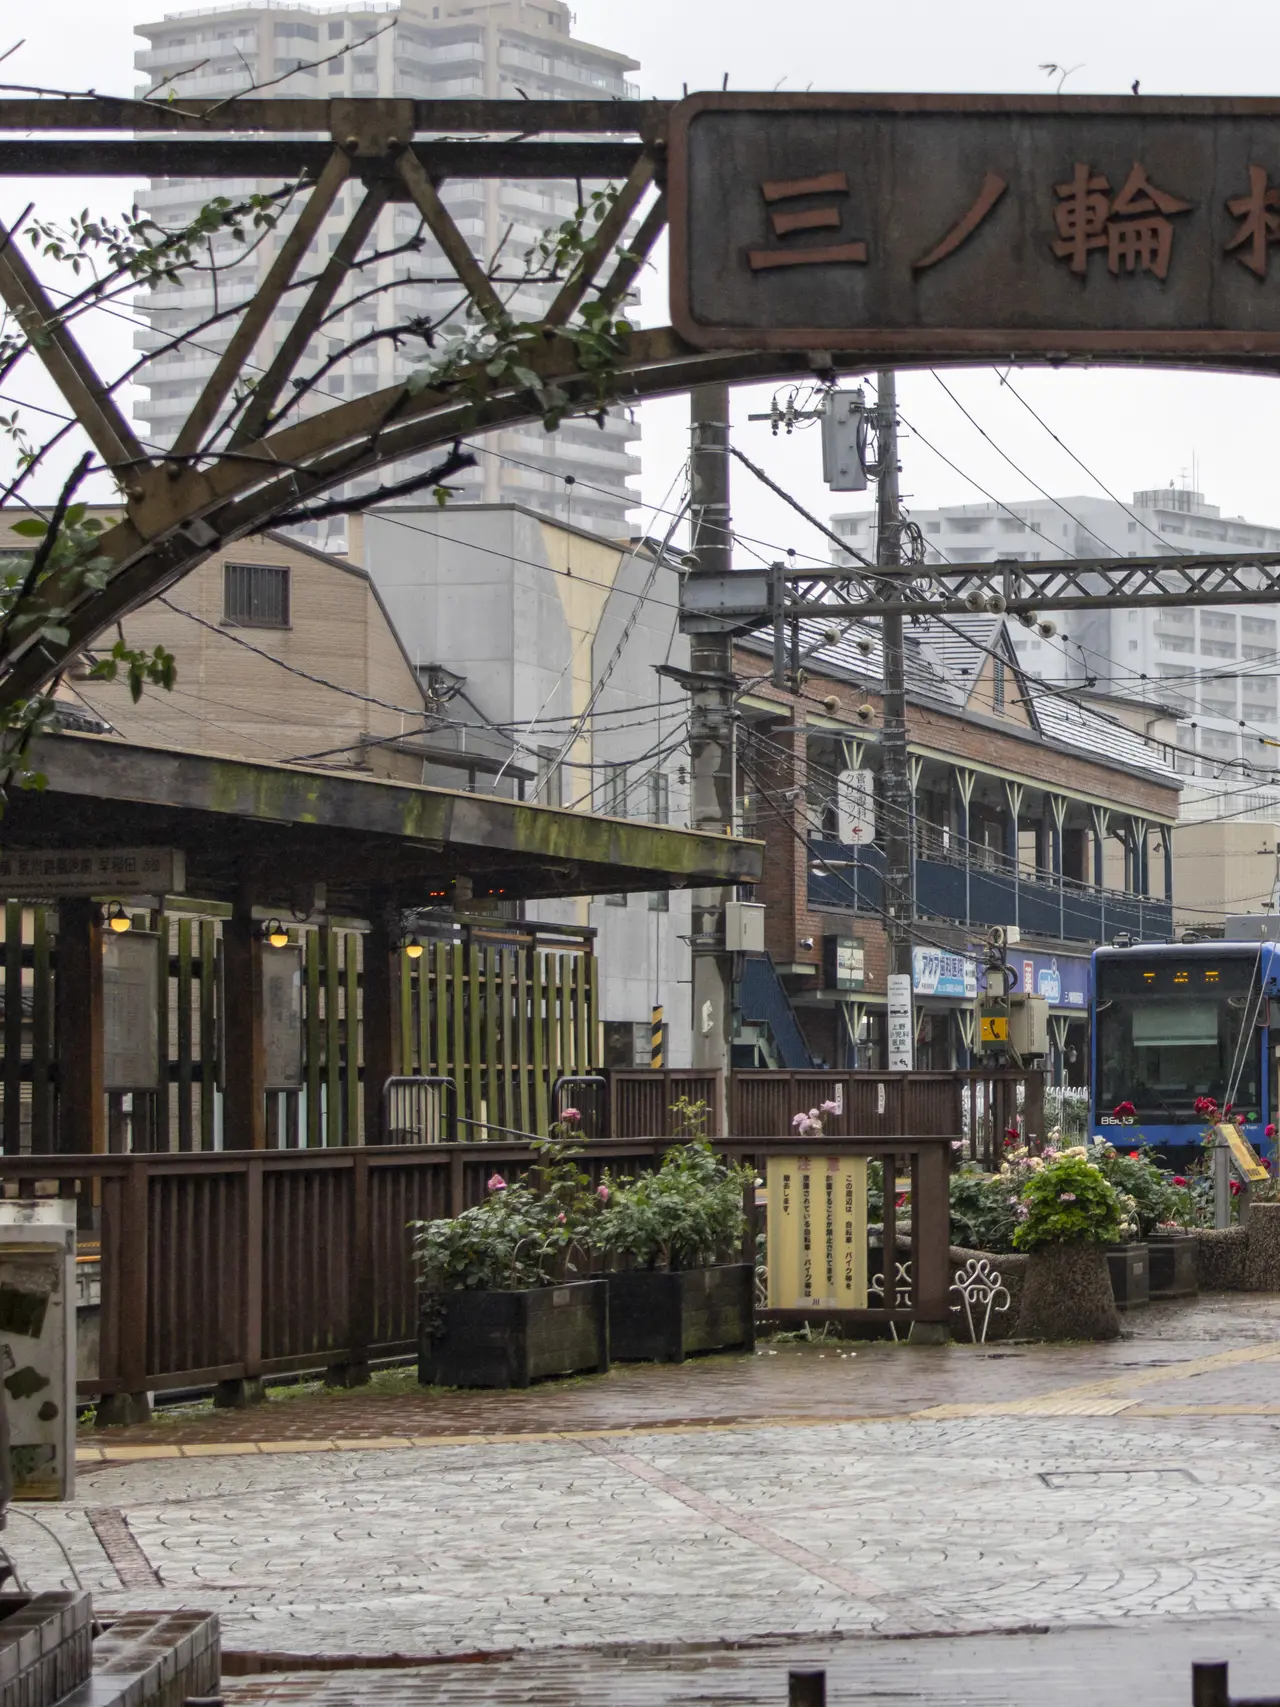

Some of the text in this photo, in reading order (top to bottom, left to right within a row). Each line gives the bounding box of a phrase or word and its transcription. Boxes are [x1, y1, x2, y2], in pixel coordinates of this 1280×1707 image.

[922, 952, 964, 978] アクア歯科医院
